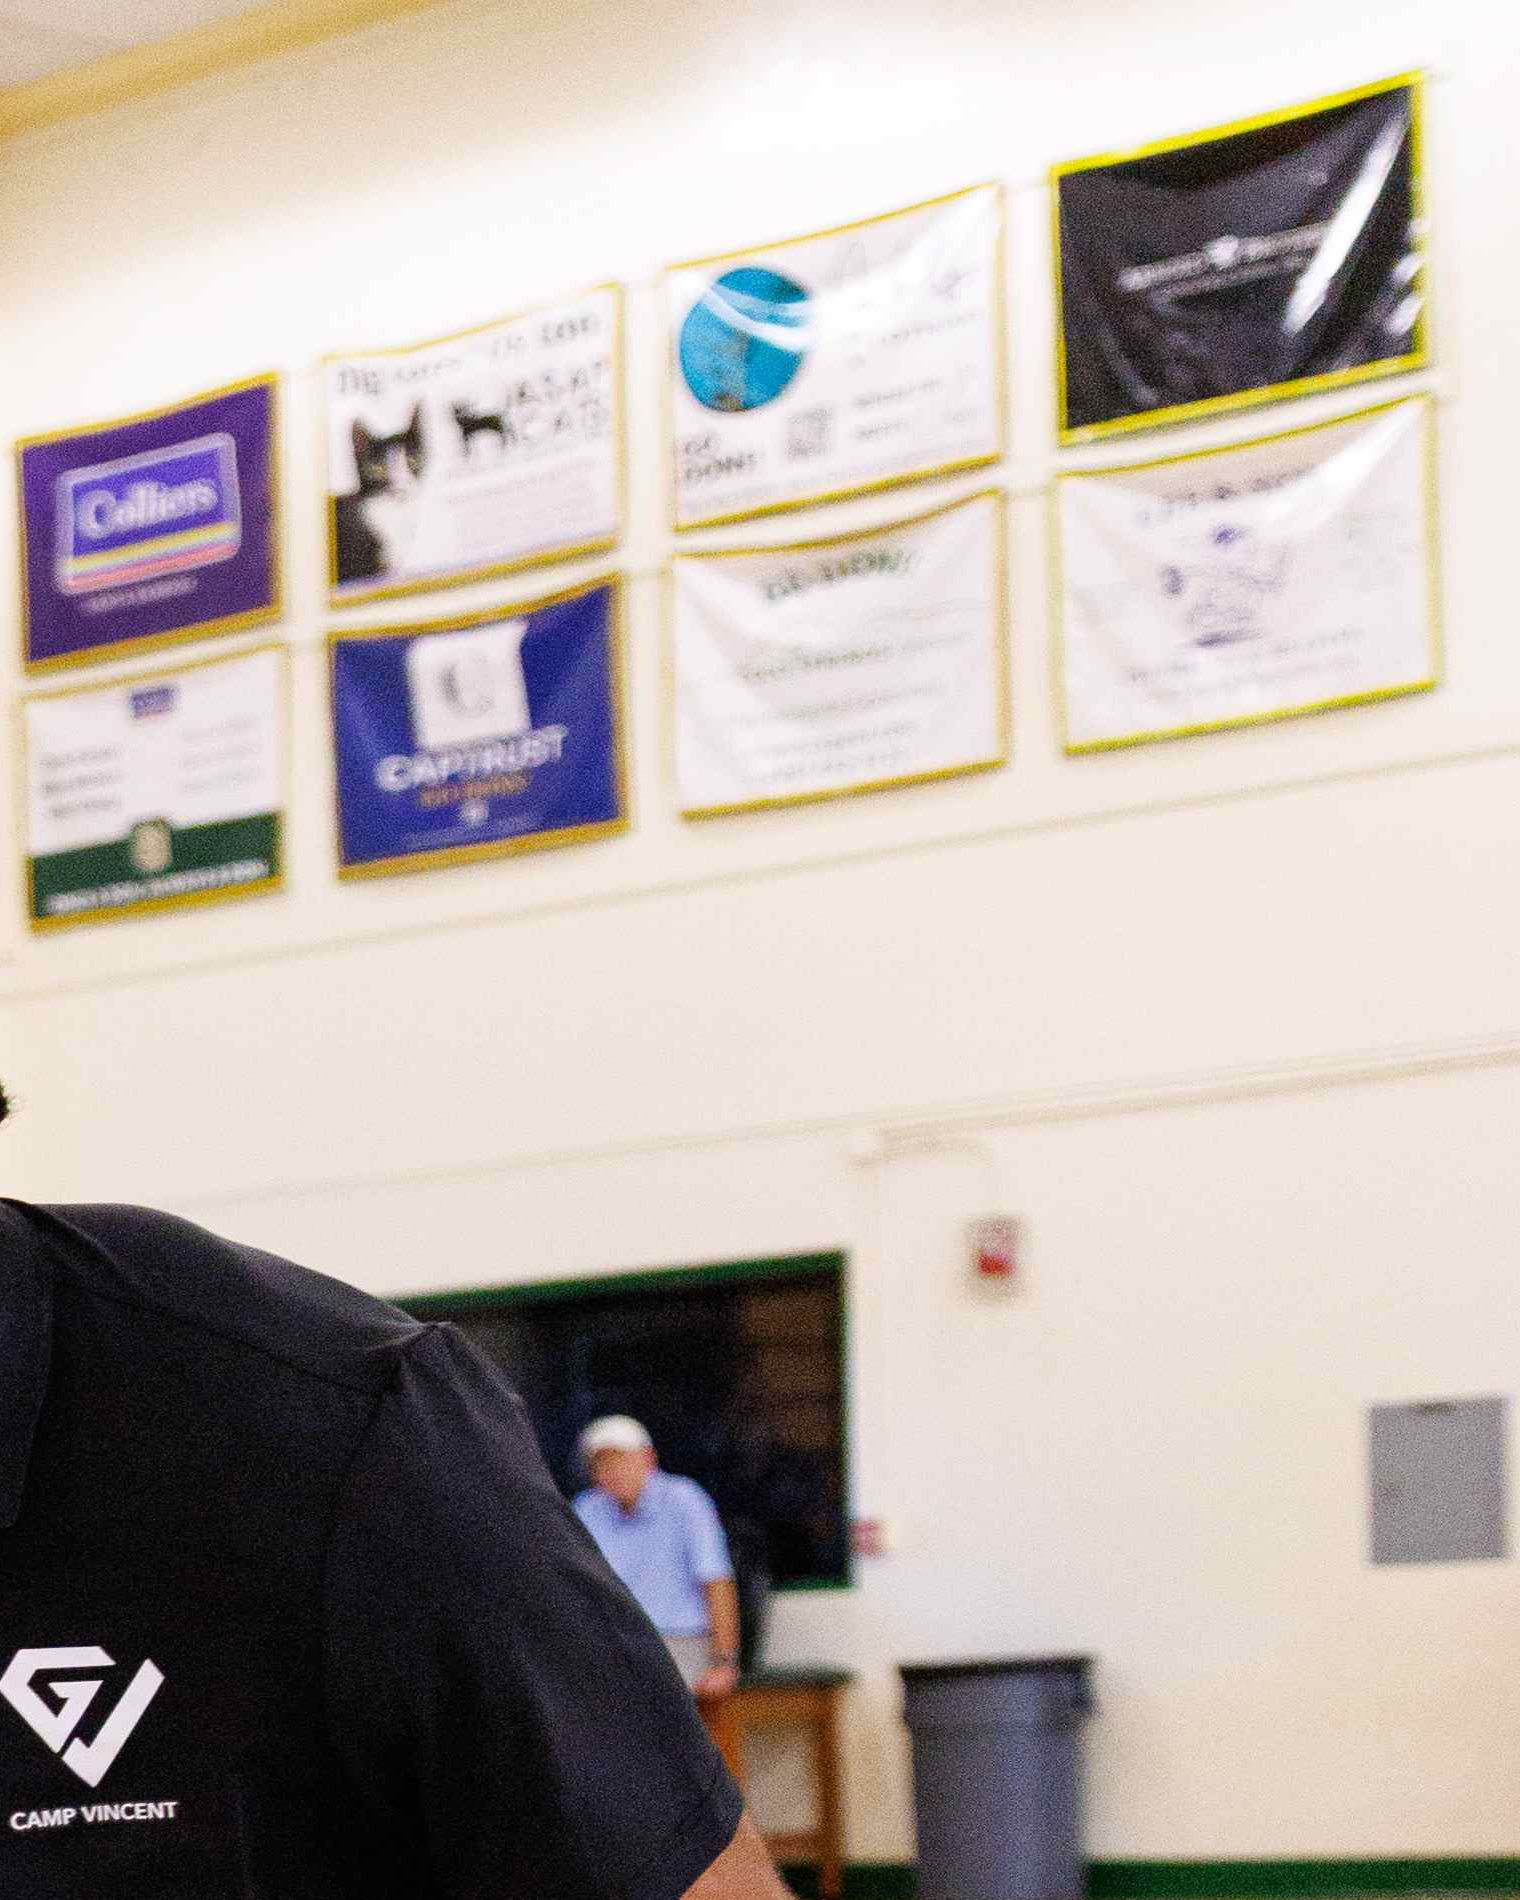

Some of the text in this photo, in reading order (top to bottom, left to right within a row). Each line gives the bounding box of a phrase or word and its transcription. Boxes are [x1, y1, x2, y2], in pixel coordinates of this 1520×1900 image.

[78, 479, 216, 541] Colliers
[374, 723, 568, 793] CAPTRUST
[9, 1800, 179, 1831] CAMP VINCENT
